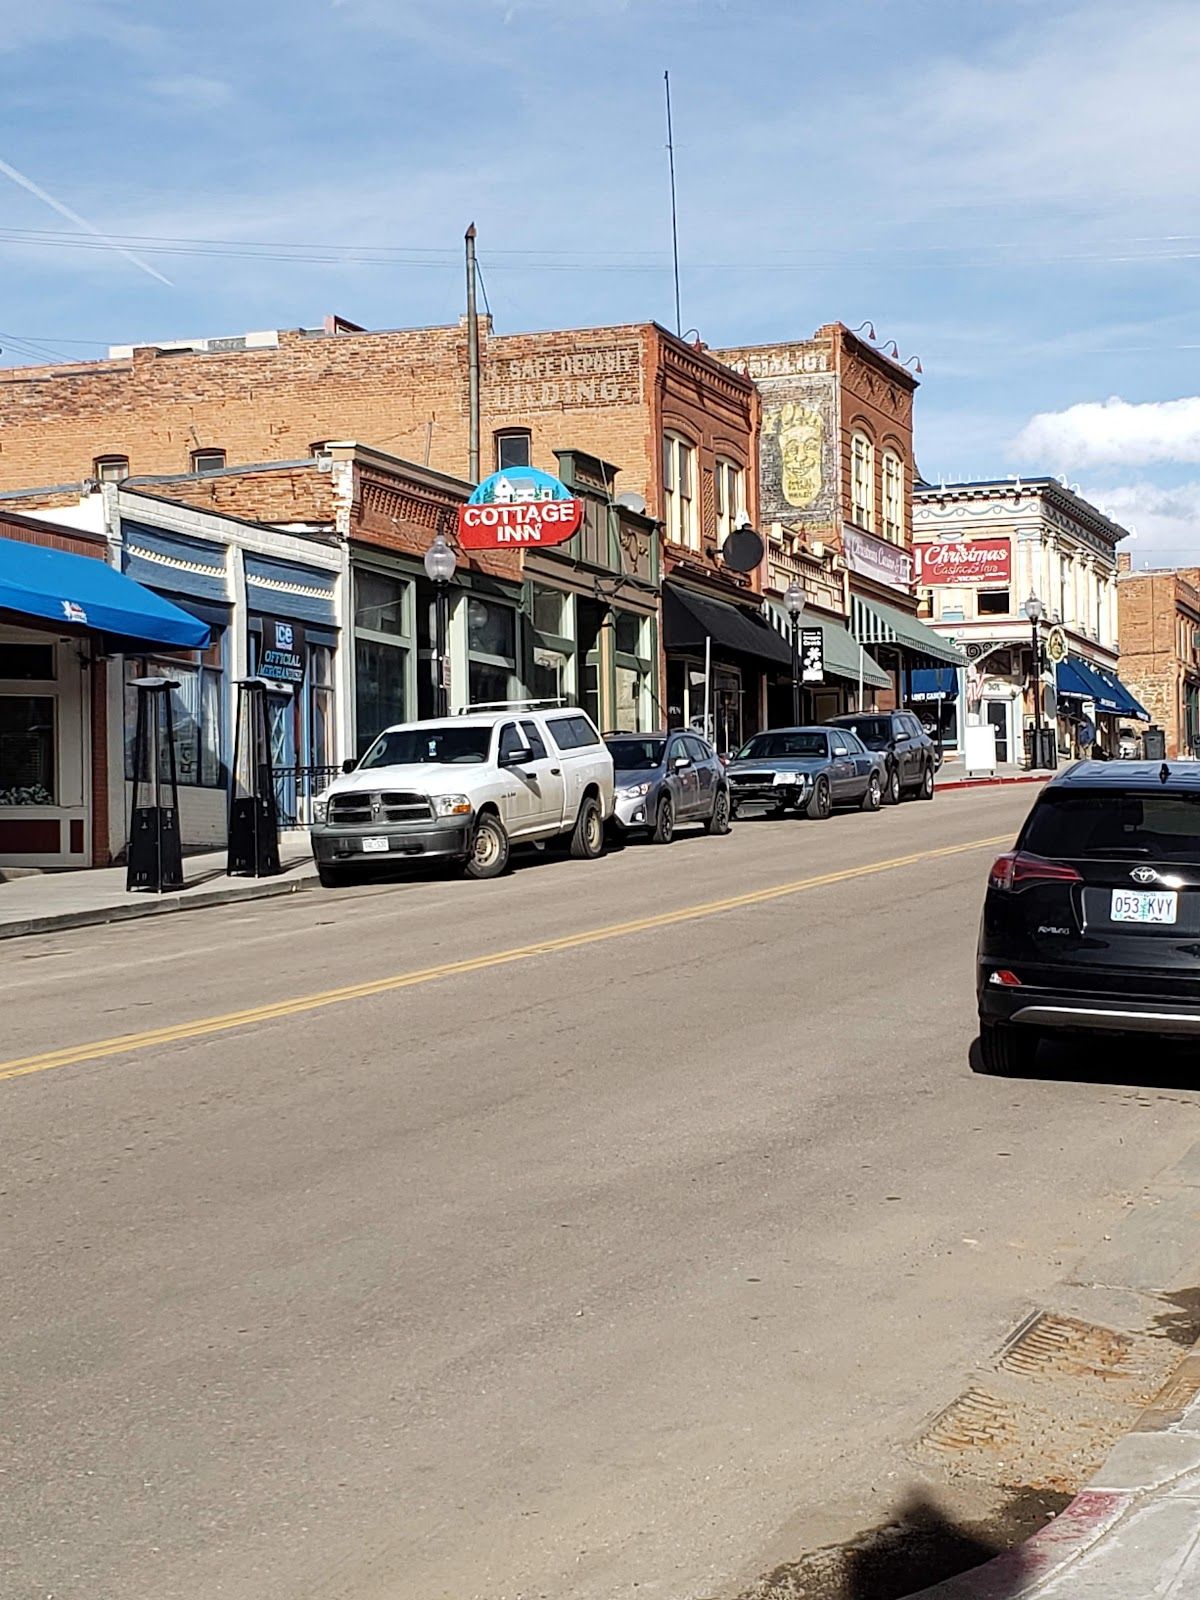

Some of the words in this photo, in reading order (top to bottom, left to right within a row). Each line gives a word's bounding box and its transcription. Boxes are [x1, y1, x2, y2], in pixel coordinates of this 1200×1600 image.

[464, 503, 575, 526] COTTAGE
[497, 523, 541, 542] INN
[924, 544, 1008, 565] Christmas
[265, 650, 302, 667] OFFICIAL
[1114, 896, 1140, 914] 053
[1147, 897, 1174, 916] KVY
